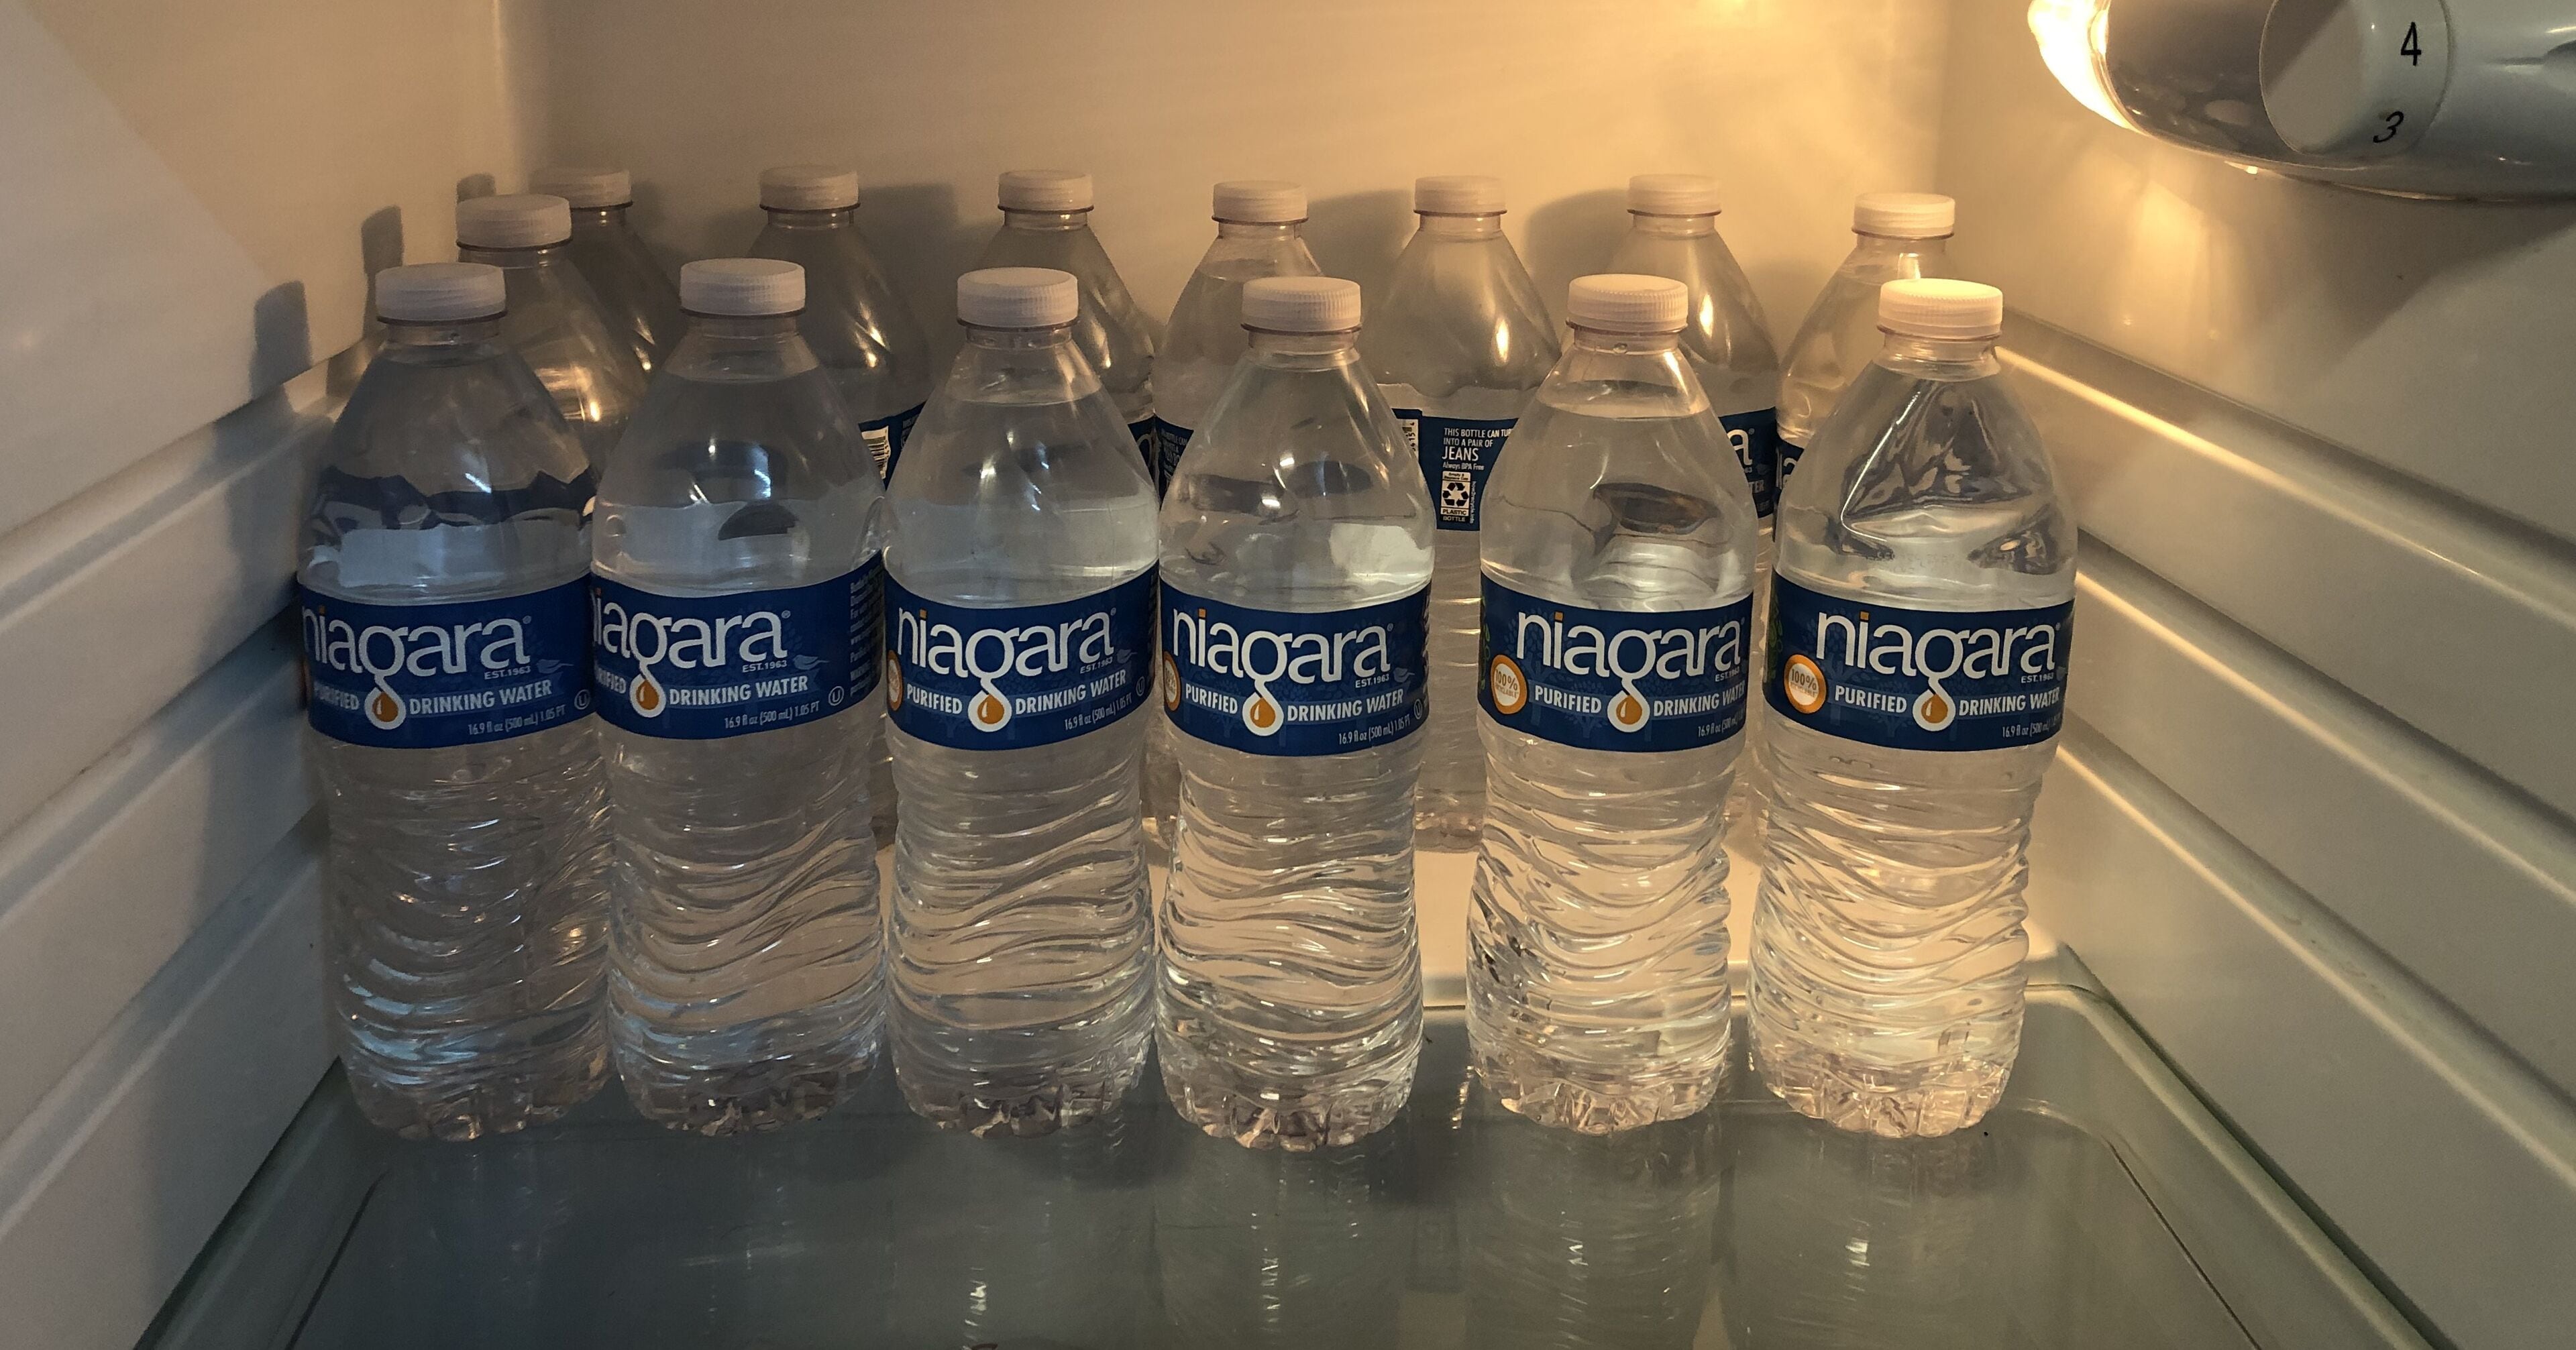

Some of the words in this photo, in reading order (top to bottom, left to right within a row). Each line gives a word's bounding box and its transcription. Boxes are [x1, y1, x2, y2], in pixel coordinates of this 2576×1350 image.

[2400, 21, 2422, 66] 4
[2373, 111, 2404, 144] 3
[1444, 428, 1459, 437] THIS
[1460, 429, 1485, 438] BOTTLE
[1487, 430, 1499, 438] CAN
[1461, 439, 1466, 447] A
[1467, 439, 1483, 447] PAIR
[1485, 439, 1493, 448] OF
[1442, 446, 1479, 461] JEANS
[1442, 461, 1460, 470] Always
[303, 606, 531, 730] niagara
[898, 607, 1114, 732] niagara
[1173, 608, 1391, 736] niagara
[1496, 669, 1517, 691] 100%
[1517, 611, 1741, 733] niagara
[1792, 669, 1817, 690] 100%
[1816, 611, 2055, 732] niagara
[409, 691, 495, 714] DRINKING
[498, 679, 552, 705] WATER
[669, 684, 751, 706] DRINKING
[755, 675, 808, 698] WATER
[907, 683, 963, 714] PURIFIED
[1016, 685, 1086, 715] DRINKING
[1090, 669, 1126, 697] WATER
[1185, 683, 1238, 714] PURIFIED
[1287, 700, 1362, 722] DRINKING
[1366, 688, 1403, 714] WATER
[1535, 685, 1602, 714] PURIFIED
[1654, 693, 1719, 716] DRINKING
[1835, 685, 1907, 714] PURIFIED
[1959, 695, 2026, 716] DRINKING
[2030, 687, 2059, 710] WATER
[468, 723, 485, 735] 16.9
[555, 704, 566, 717] PT
[724, 716, 740, 728] 16.9
[760, 710, 777, 726] (500
[778, 707, 793, 721] mL)
[810, 701, 820, 713] PT
[1065, 716, 1077, 730] 16.9
[1092, 707, 1106, 724] (500
[1339, 732, 1352, 744] 16.9
[1354, 730, 1358, 742] fl
[1360, 732, 1367, 741] oz
[1368, 725, 1382, 742] (500
[1383, 721, 1394, 735] mL)
[1394, 716, 1405, 731] 1.05
[1405, 714, 1410, 727] PT
[1698, 724, 1710, 737] 16.9
[2002, 726, 2015, 738] 16.9
